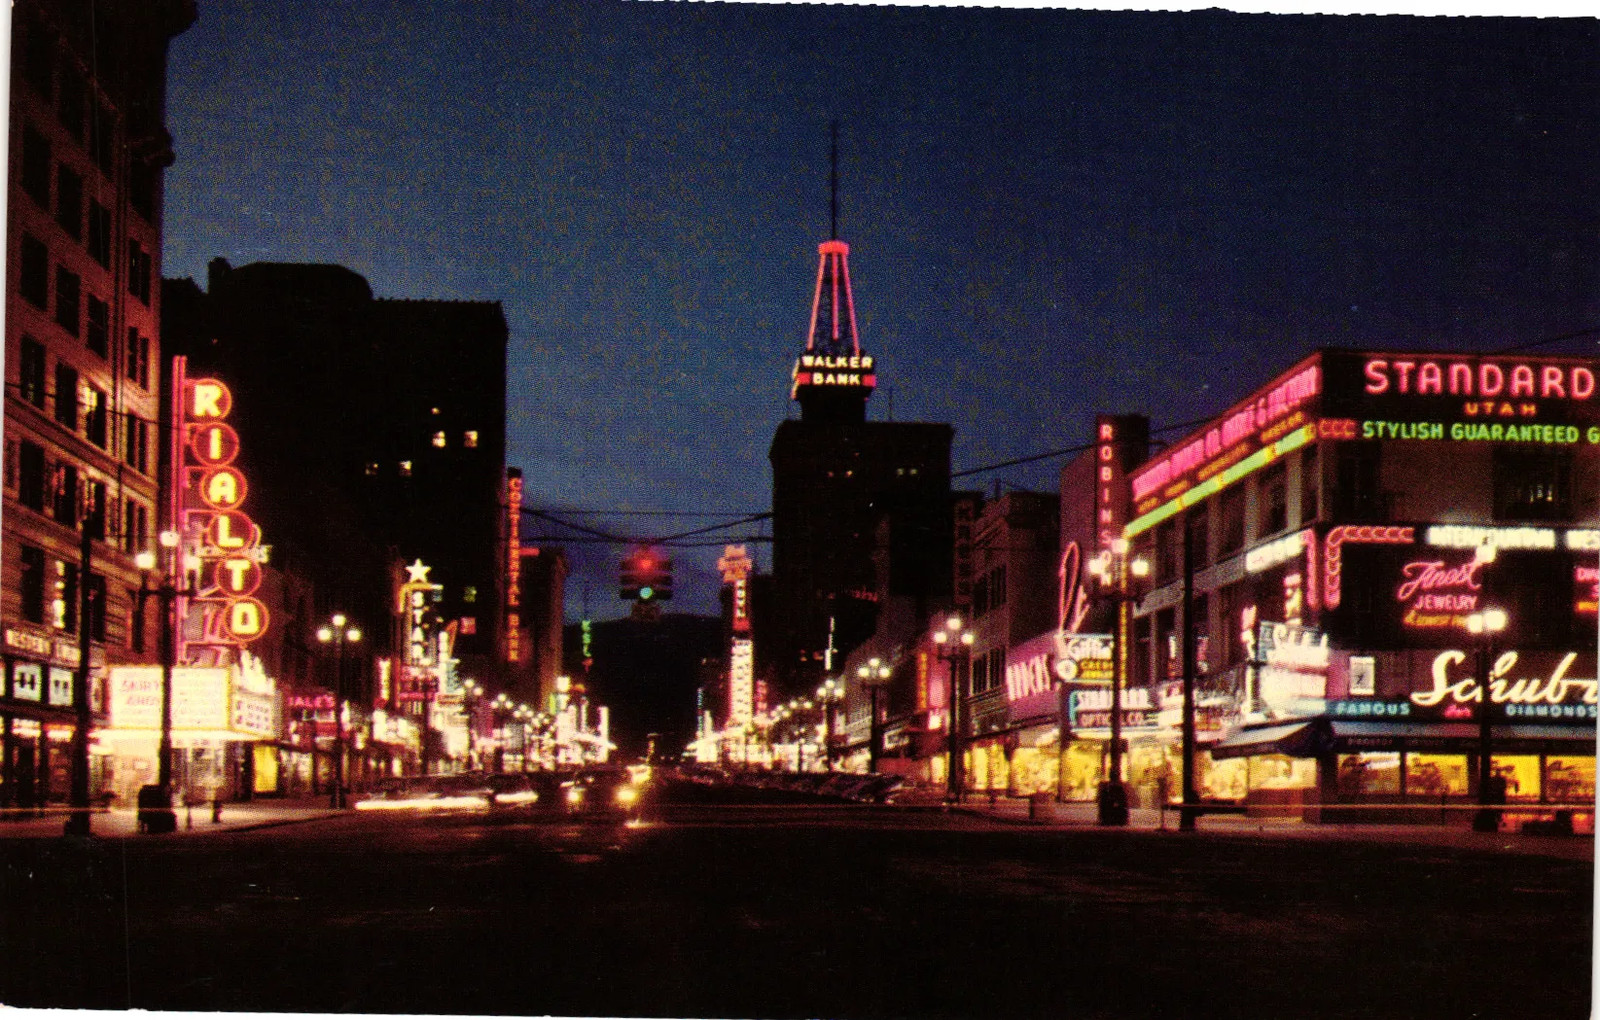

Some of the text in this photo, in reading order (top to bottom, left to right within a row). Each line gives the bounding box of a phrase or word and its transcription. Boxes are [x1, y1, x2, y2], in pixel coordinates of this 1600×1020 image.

[802, 356, 873, 368] WALKER
[812, 372, 860, 386] BANK
[1364, 360, 1595, 399] STANDARD
[1463, 402, 1538, 416] UTAH
[1362, 421, 1444, 441] STYLISH
[1450, 423, 1579, 443] GUARANTEED
[1099, 423, 1113, 587] ROBINSON
[193, 383, 260, 643] RIALTO
[1415, 595, 1478, 611] JEWELRY
[1336, 703, 1411, 716] FAMOUS
[1505, 703, 1598, 718] DIAMONDS
[1081, 713, 1125, 727] OPTICL
